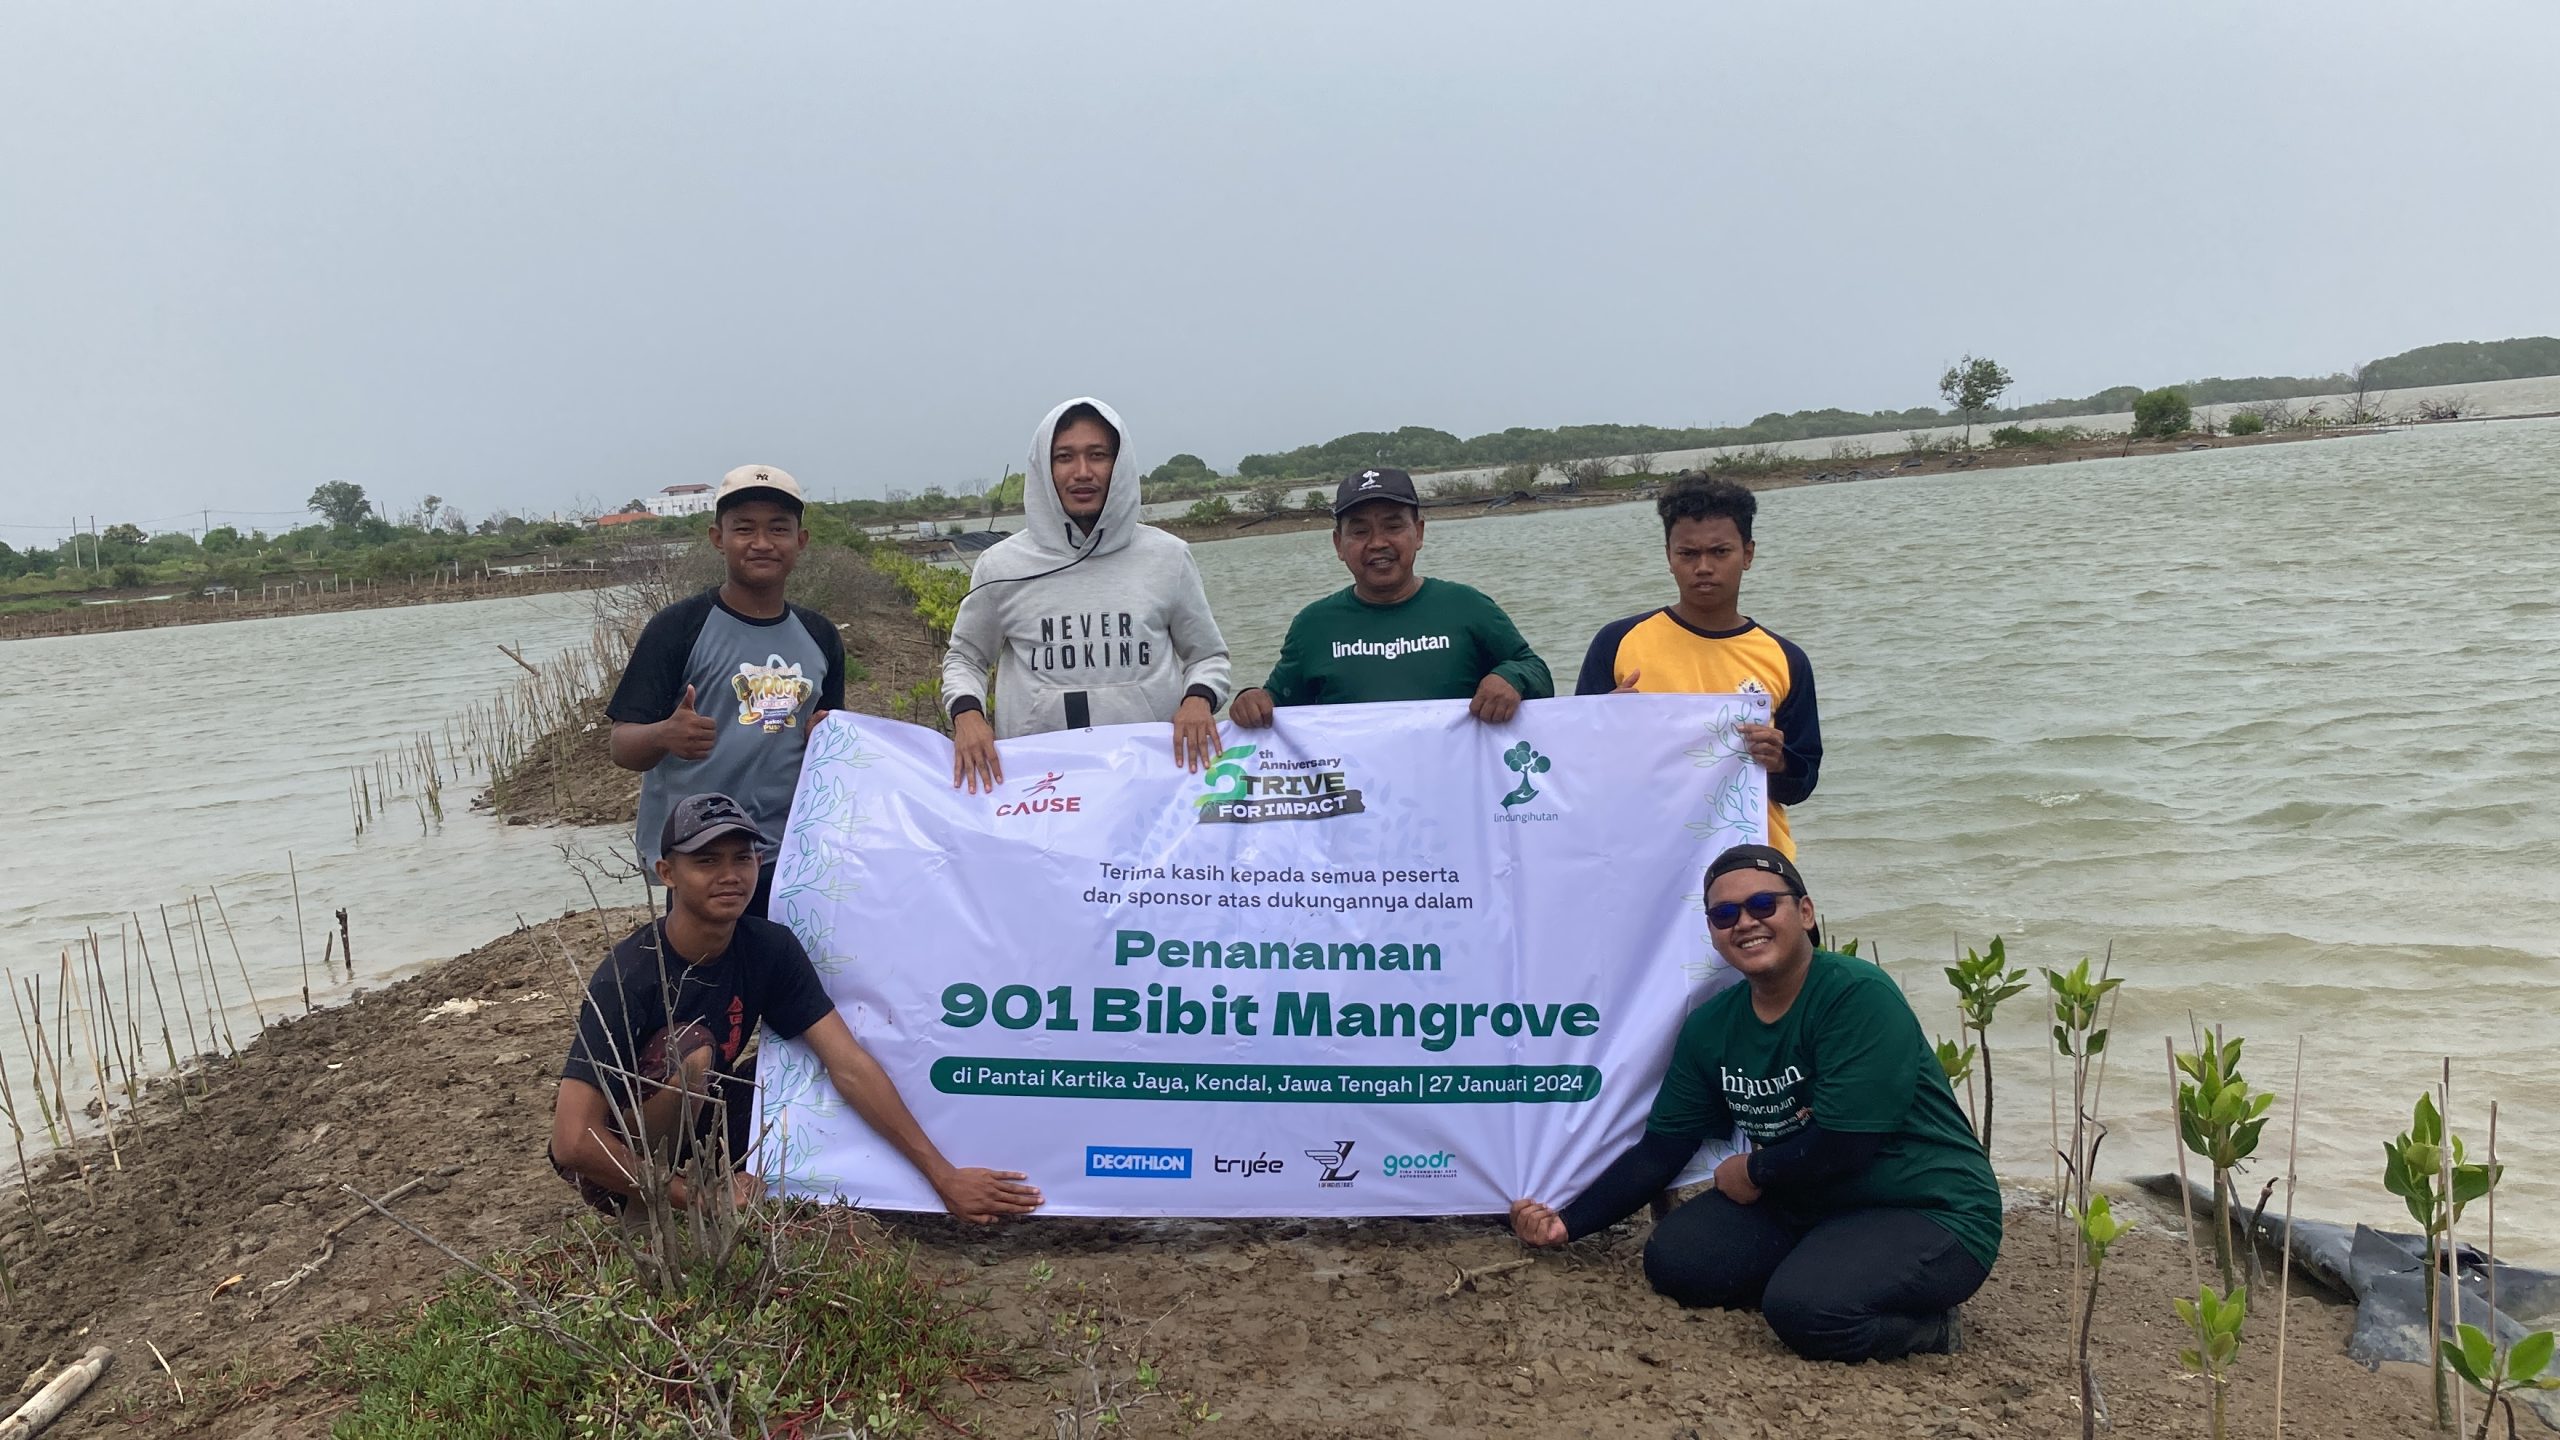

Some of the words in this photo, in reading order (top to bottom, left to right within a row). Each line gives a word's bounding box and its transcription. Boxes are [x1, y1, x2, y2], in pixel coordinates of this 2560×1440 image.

[1041, 612, 1132, 642] NEVER
[1031, 641, 1151, 671] LOOKING
[1332, 635, 1450, 660] lindungihutan
[1259, 757, 1341, 771] Anniversary
[996, 796, 1081, 817] CAUSE
[1219, 803, 1261, 818] FOR
[1264, 795, 1347, 817] IMPACT
[1494, 812, 1558, 823] lindungihutan
[1099, 862, 1166, 881] Terima
[1171, 863, 1224, 881] kasih
[1231, 866, 1305, 887] kepada
[1311, 869, 1376, 884] semua
[1382, 867, 1460, 887] peserta
[1083, 886, 1121, 904] dan
[1127, 890, 1212, 908] sponsor
[1218, 892, 1262, 908] atas
[1267, 891, 1409, 913] dukungannya
[1414, 891, 1473, 909] dalam
[1115, 929, 1442, 971] Penanaman
[940, 982, 1079, 1031] 901
[1092, 982, 1259, 1036] Bibit
[1272, 991, 1600, 1052] Mangrove
[951, 1066, 972, 1084] di
[978, 1067, 1045, 1086] Pantai
[1051, 1069, 1127, 1089] Kartika
[1132, 1071, 1189, 1094] Jaya,
[1195, 1073, 1273, 1094] Kendal,
[1277, 1074, 1333, 1093] Jawa
[1338, 1075, 1413, 1097] Tengah
[1429, 1075, 1453, 1093] 27
[1458, 1075, 1527, 1093] Januari
[1533, 1074, 1584, 1093] 2024
[1092, 1153, 1185, 1171] DECATHLON
[1383, 1150, 1456, 1177] goodr
